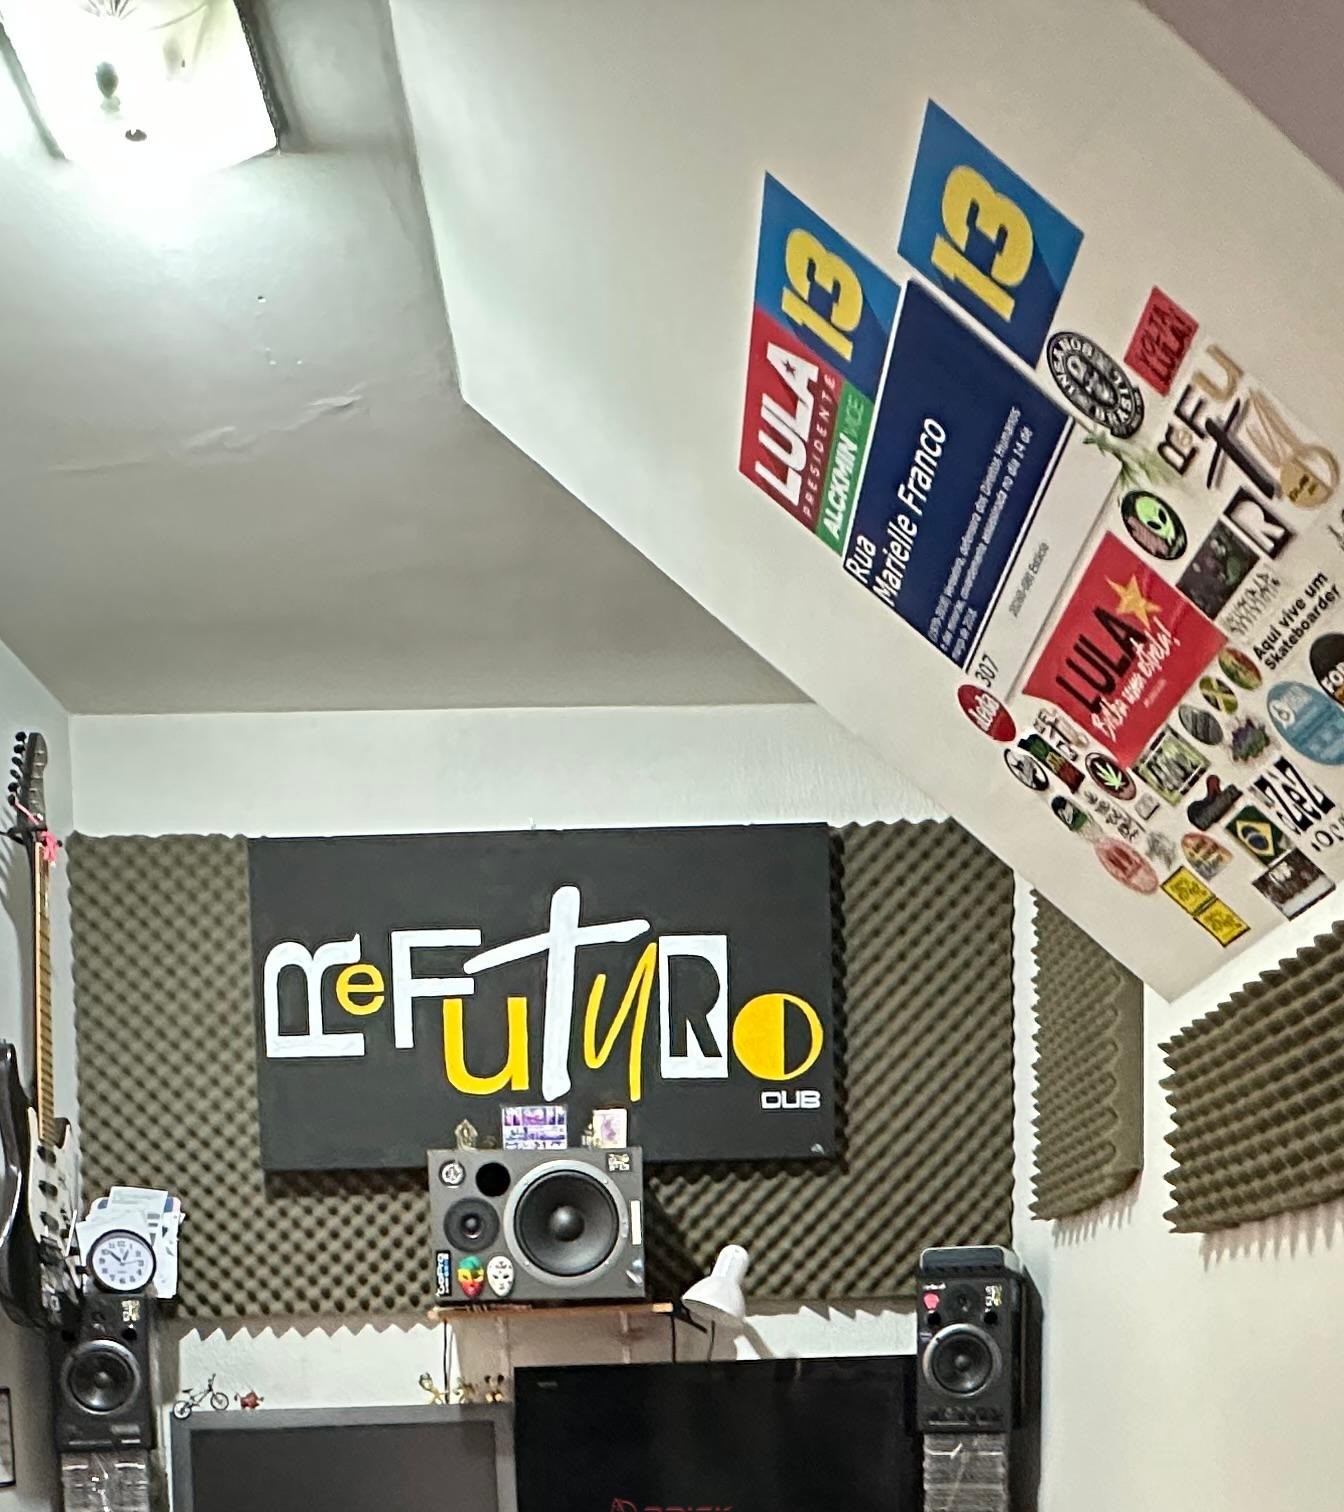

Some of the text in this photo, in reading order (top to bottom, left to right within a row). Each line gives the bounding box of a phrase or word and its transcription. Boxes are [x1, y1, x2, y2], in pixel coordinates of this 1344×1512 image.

[931, 164, 1034, 322] 13
[781, 228, 863, 361] 13
[755, 342, 818, 505] LULA
[803, 373, 836, 519] PRESIDENTE
[823, 393, 864, 540] ALCKMIN VICE
[994, 406, 1021, 458] Humanos
[1013, 442, 1026, 459] 14
[1007, 458, 1021, 477] dia
[871, 418, 946, 607] Marielle Franco
[845, 534, 876, 586] Rua
[1129, 616, 1181, 678] estrela!
[1253, 572, 1328, 661] Aqui vive um
[1264, 584, 1340, 670] Skateboarder
[975, 654, 998, 687] 307
[1056, 607, 1148, 714] LULA
[1121, 672, 1146, 704] uma
[762, 1091, 821, 1109] DUB
